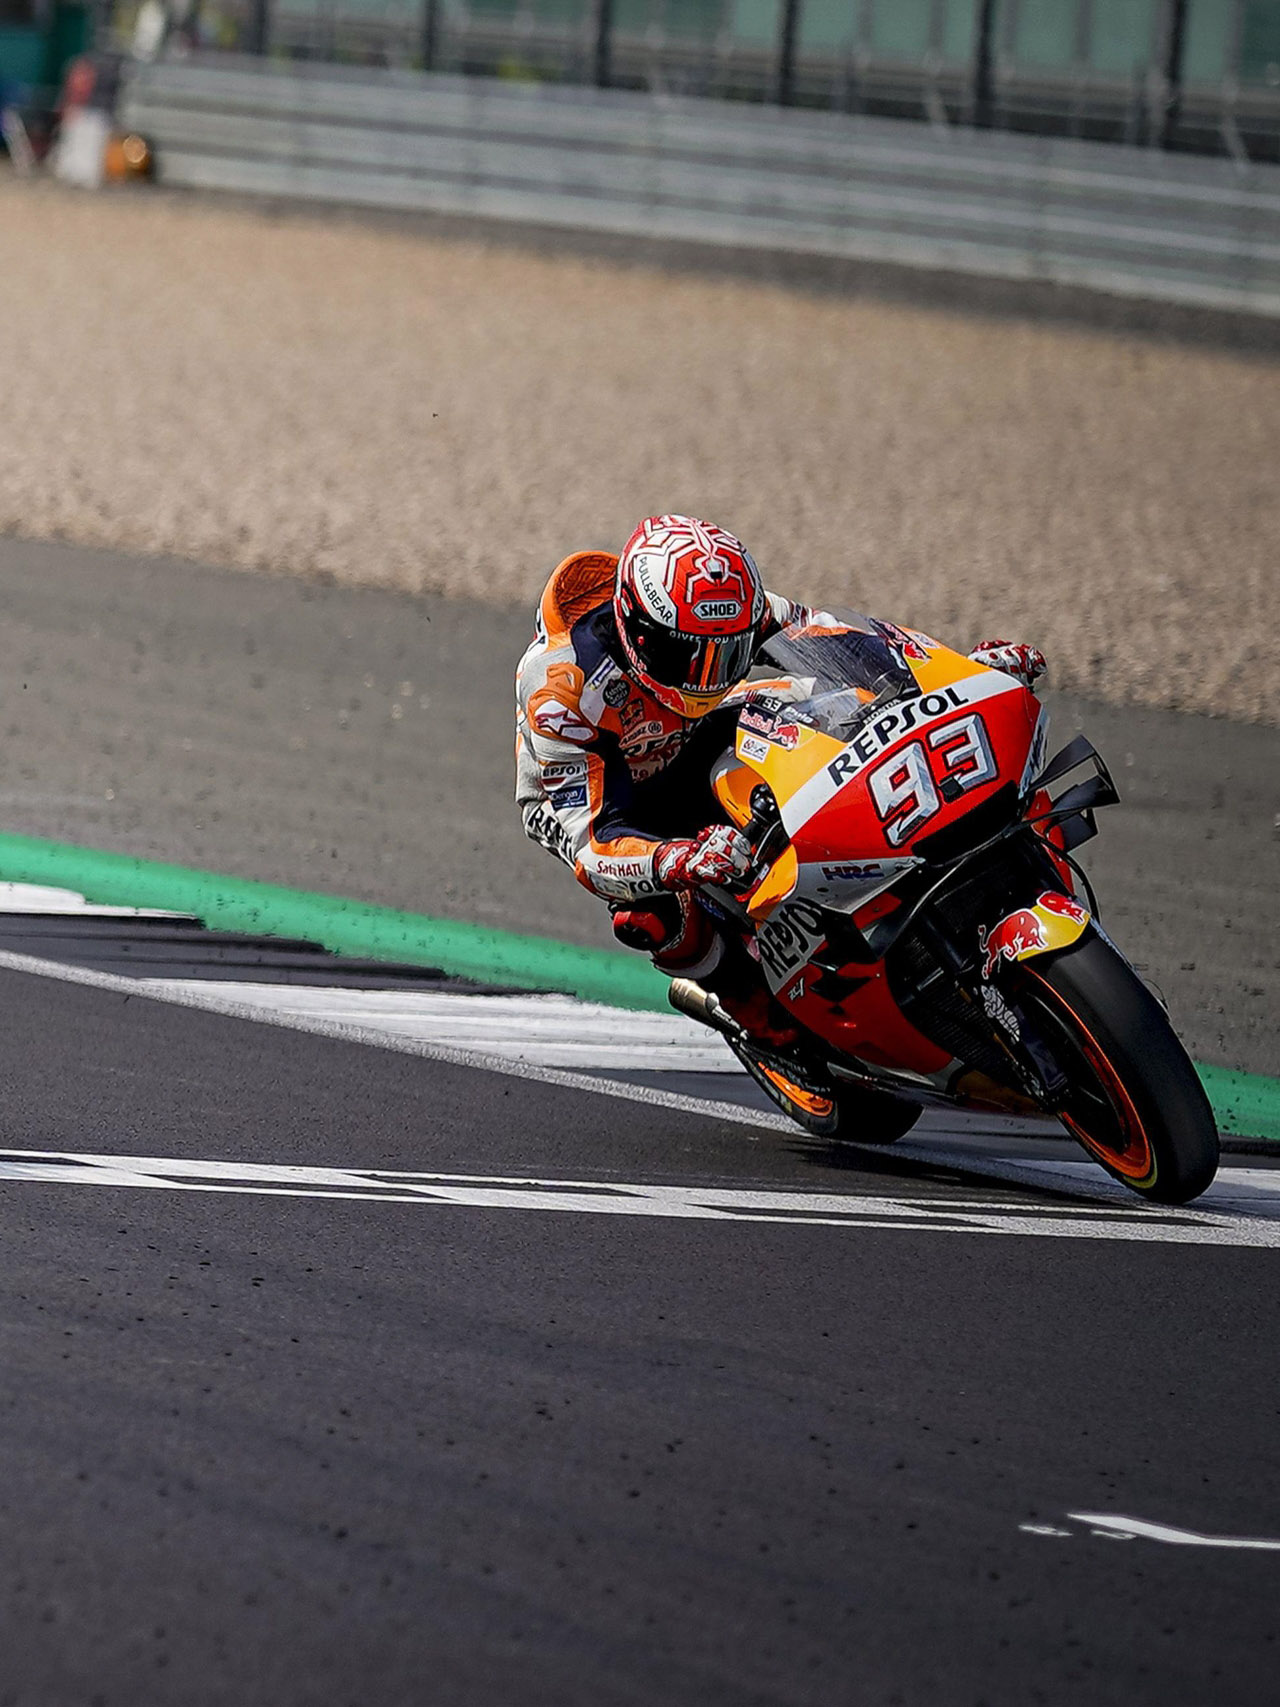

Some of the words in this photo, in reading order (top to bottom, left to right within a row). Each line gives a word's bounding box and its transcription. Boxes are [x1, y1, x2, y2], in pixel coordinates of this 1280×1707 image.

[638, 555, 673, 623] PULL&BEAR
[700, 602, 737, 617] SHOEI
[762, 697, 783, 712] 93
[827, 687, 969, 787] REPSOL
[866, 711, 999, 849] 93
[822, 863, 884, 881] HRC
